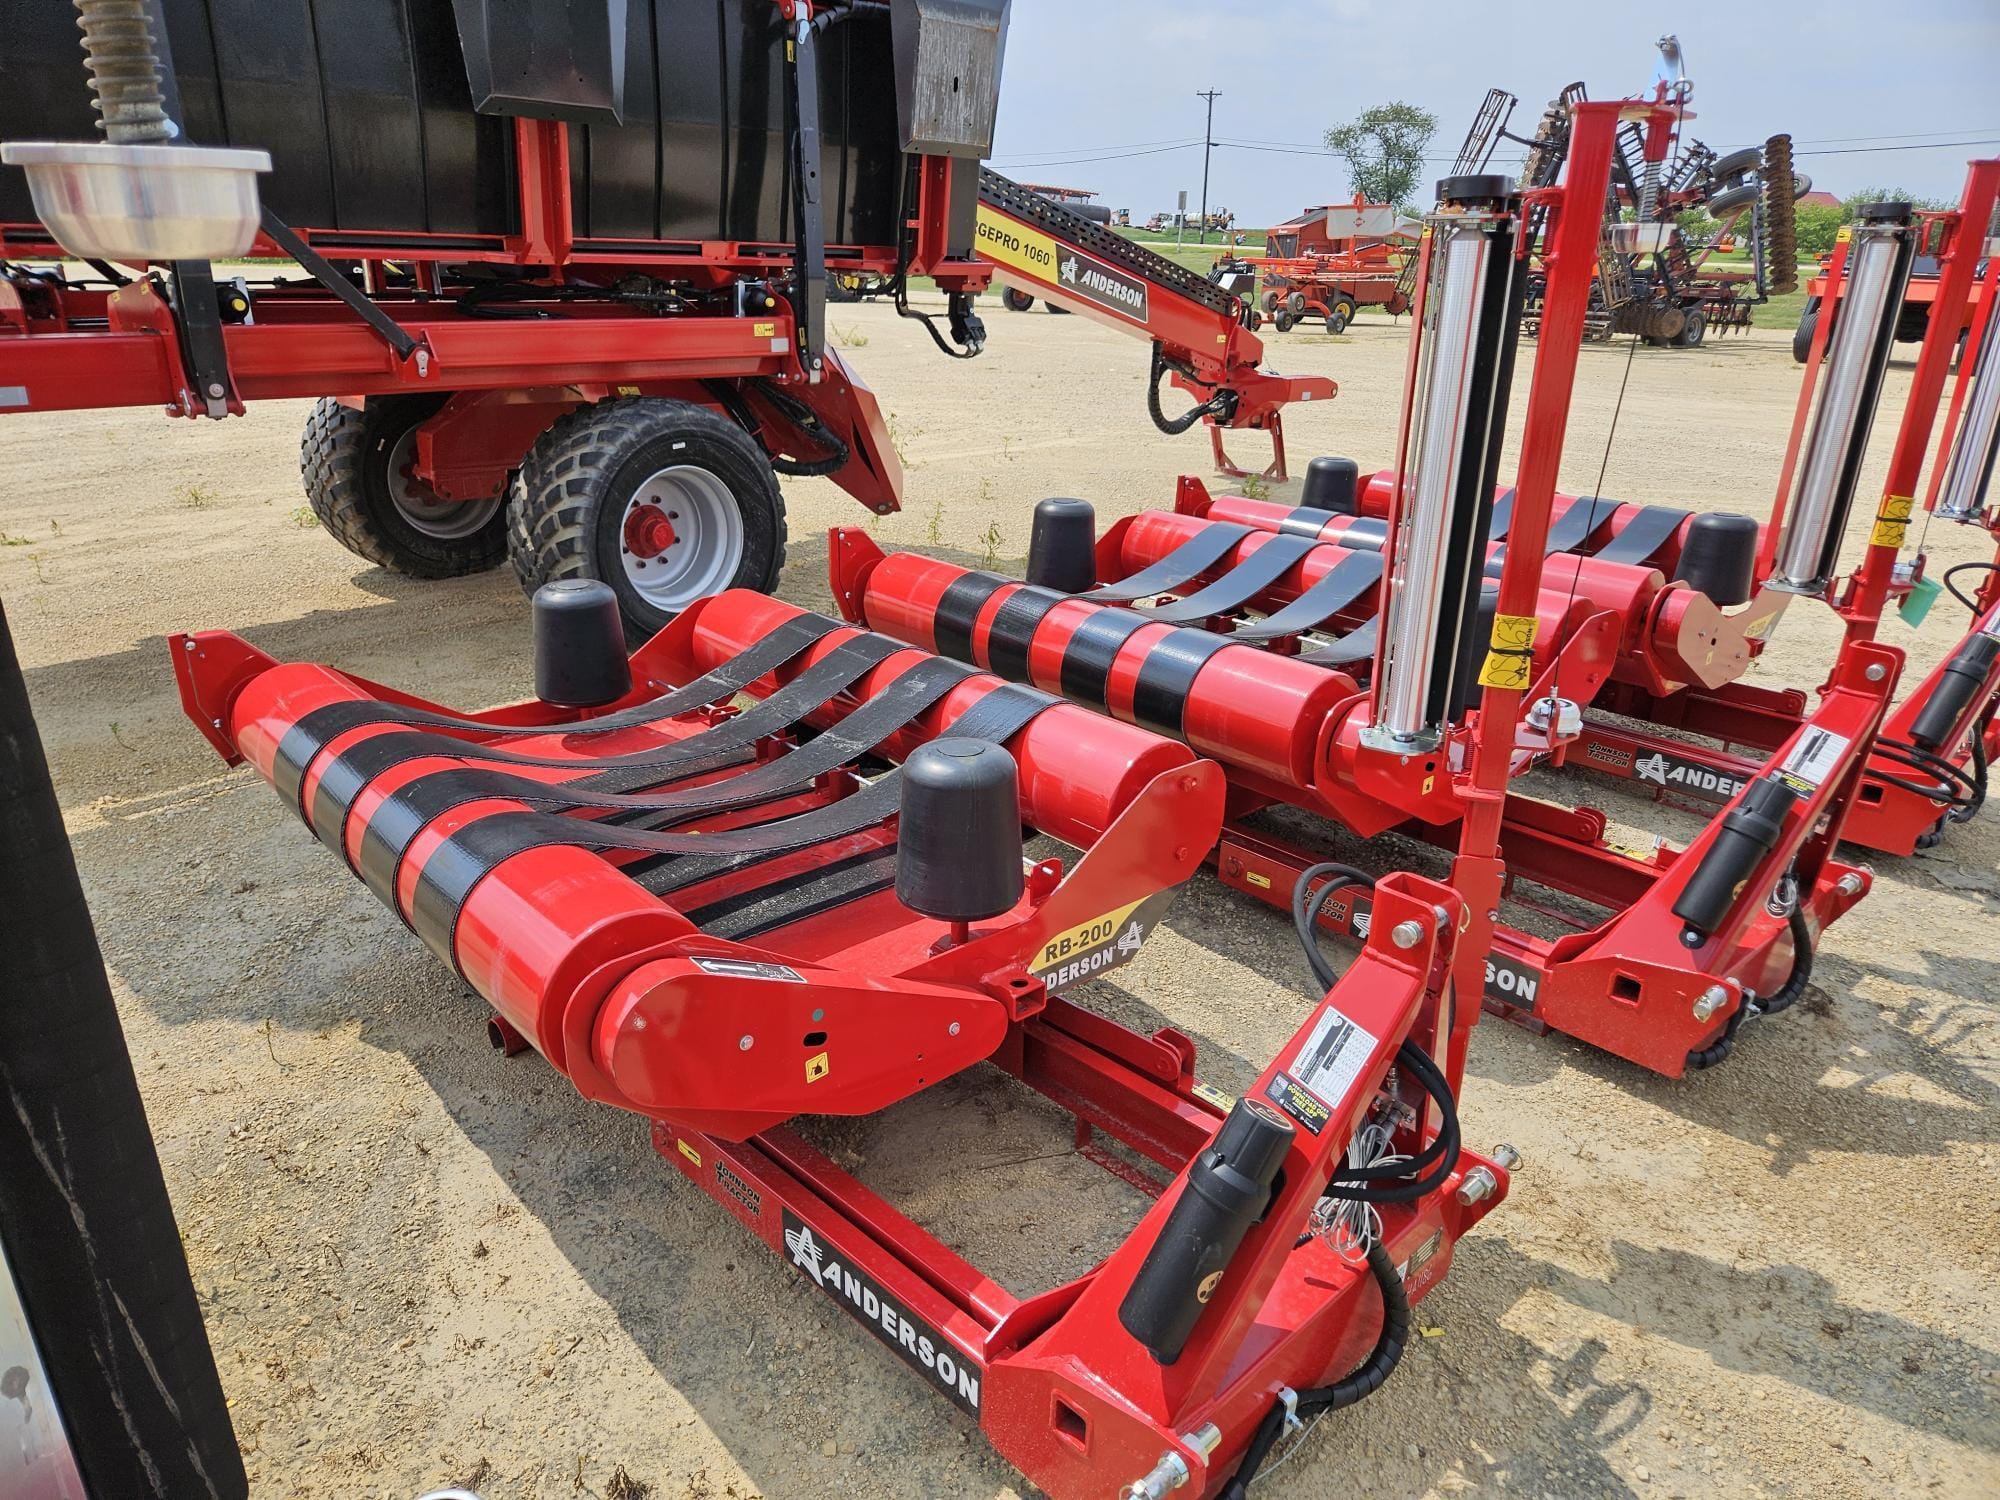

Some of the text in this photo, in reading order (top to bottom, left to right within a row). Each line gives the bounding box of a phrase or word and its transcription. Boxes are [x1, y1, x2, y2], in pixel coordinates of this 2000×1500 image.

[1024, 243, 1050, 266] 1060
[1080, 269, 1144, 309] ANDERSON
[1587, 742, 1632, 760] JOHNSON
[1587, 749, 1630, 768] TRACTOR
[1667, 766, 1747, 798] ANDER
[1045, 919, 1113, 963] RB-200
[1041, 946, 1113, 992] DERSON
[1286, 1084, 1317, 1110] DOWNLOAD
[1315, 1107, 1329, 1120] OUR
[1291, 1095, 1306, 1109] FREE
[1304, 1105, 1318, 1118] APP
[715, 1160, 760, 1203] JOHNSON
[716, 1170, 760, 1216] TRACTOR
[822, 1261, 979, 1408] ANDERSON
